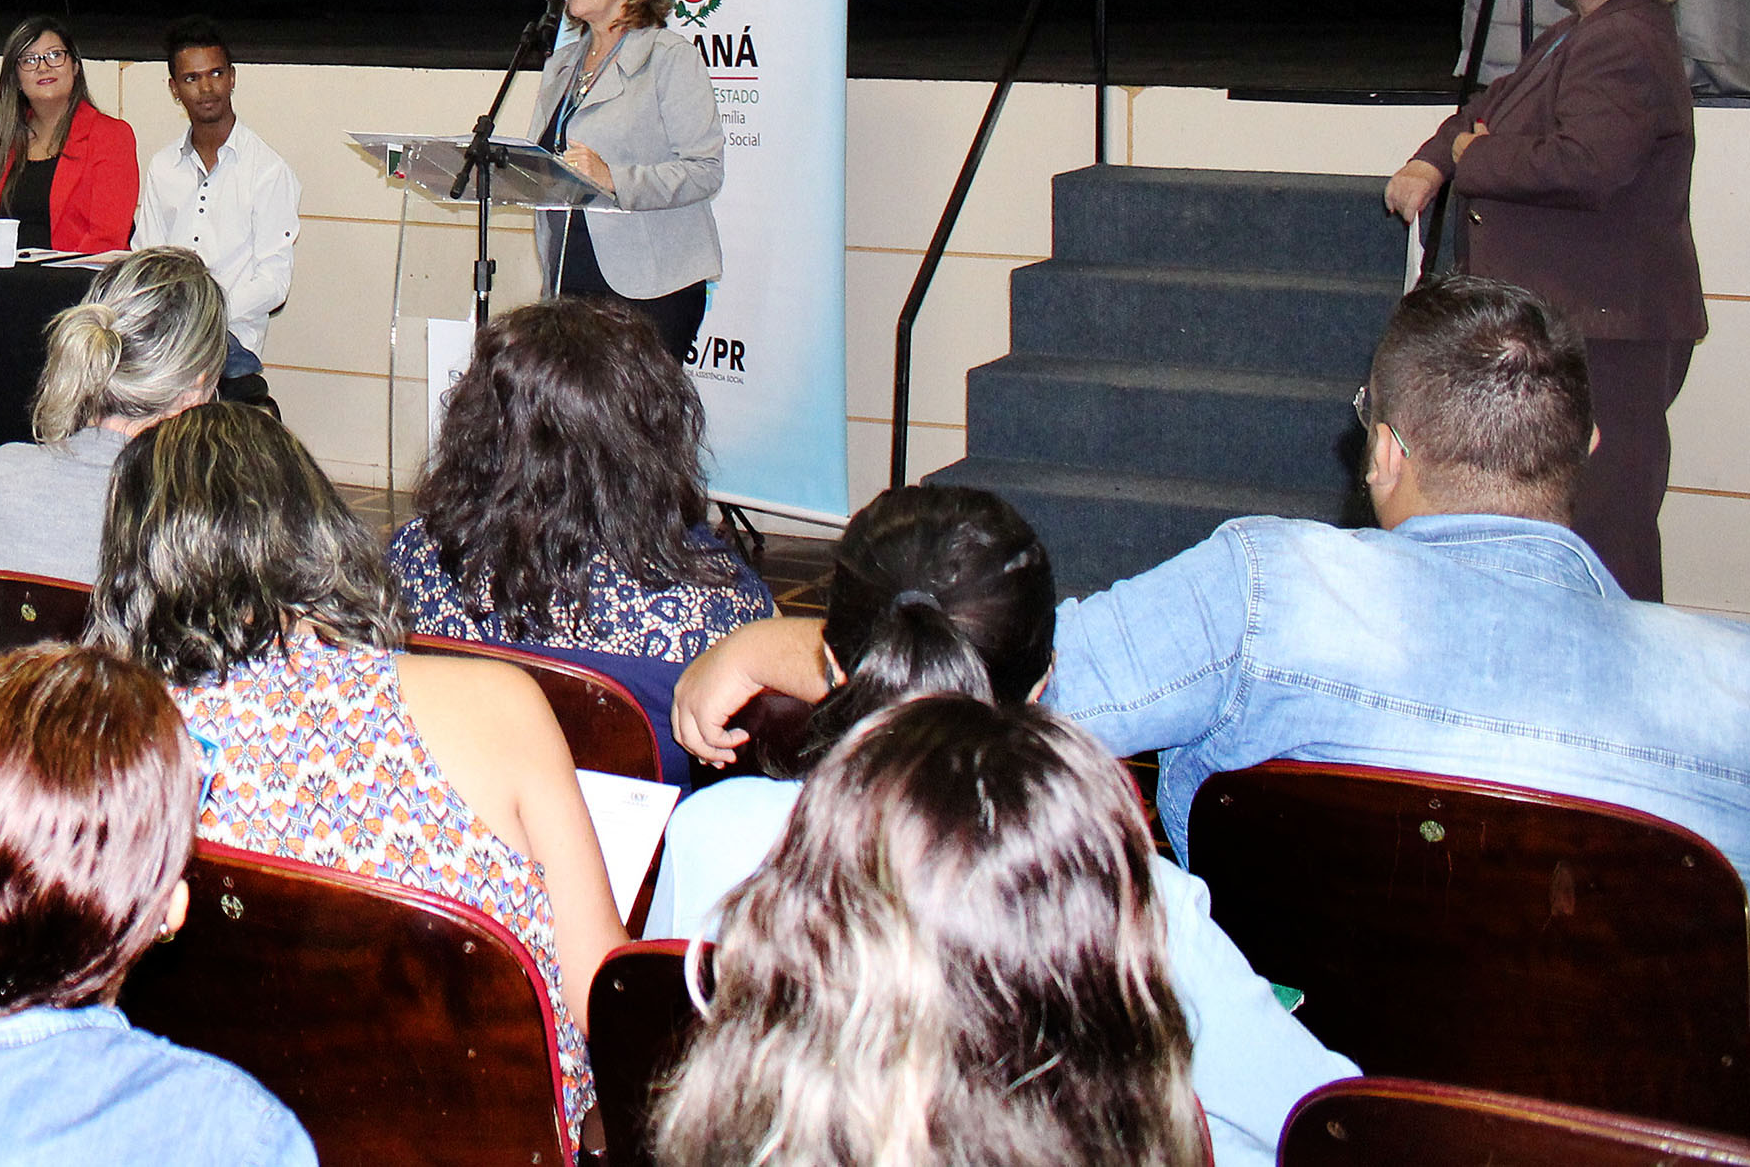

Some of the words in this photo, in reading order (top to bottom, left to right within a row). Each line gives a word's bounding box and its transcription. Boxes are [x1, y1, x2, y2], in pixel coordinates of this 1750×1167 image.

[694, 25, 759, 68] ANÁ
[713, 87, 760, 104] ESTADO
[721, 110, 746, 125] mília
[729, 132, 761, 147] Social
[684, 336, 746, 372] S/PR
